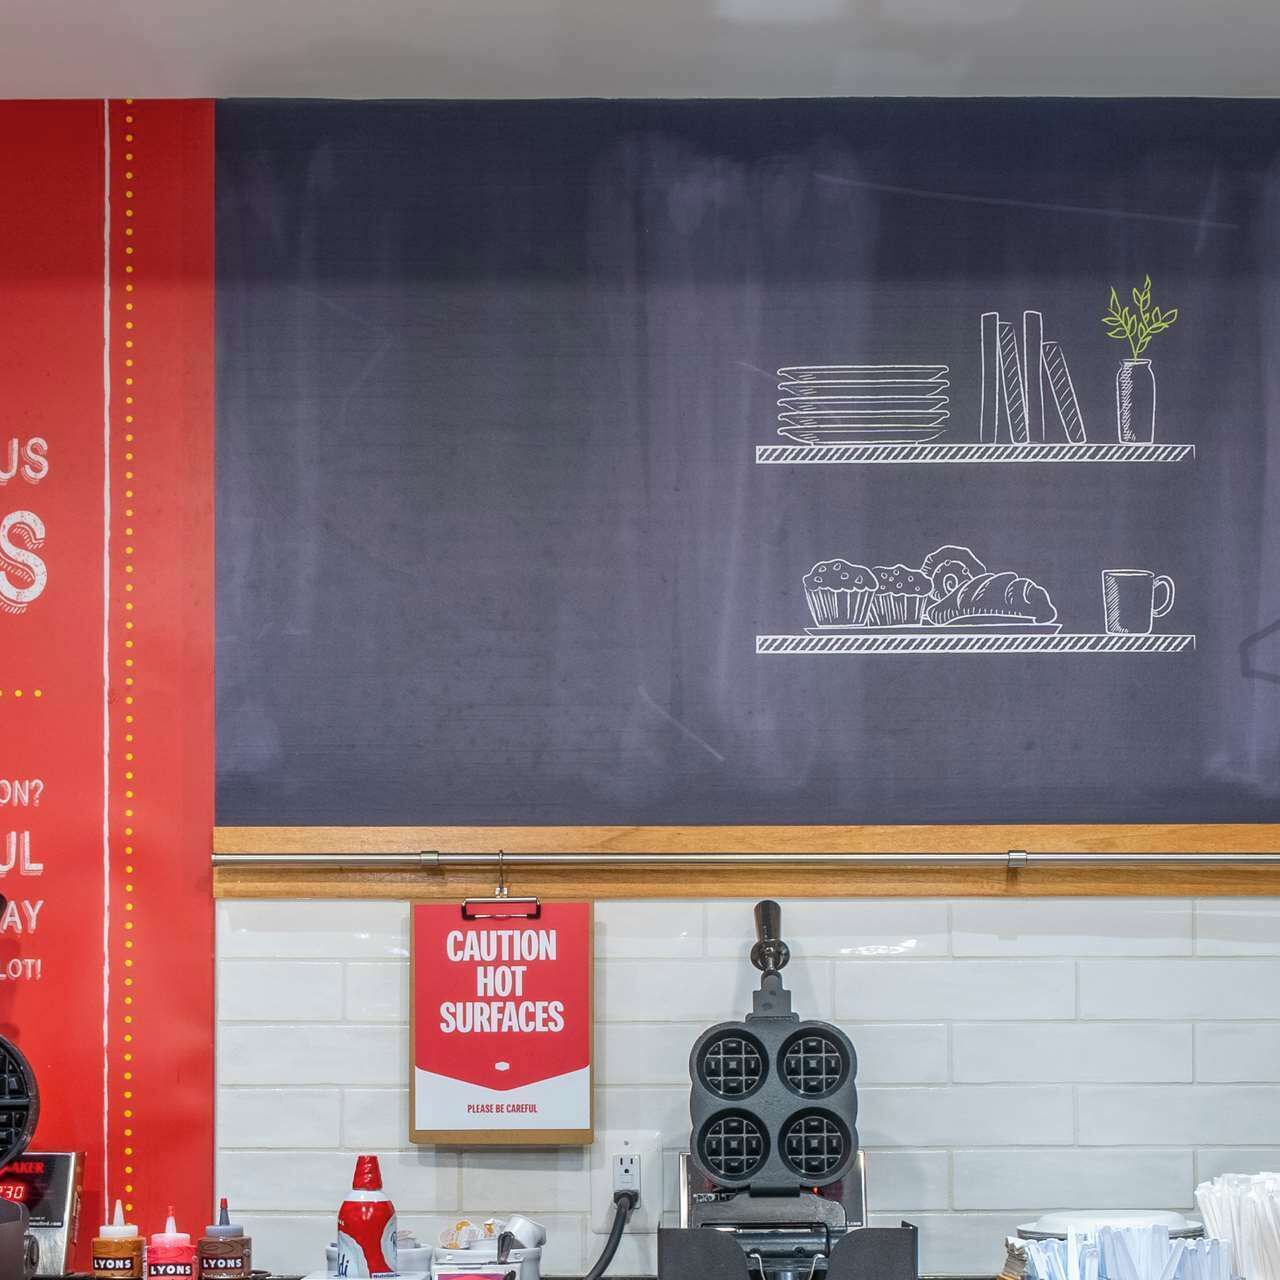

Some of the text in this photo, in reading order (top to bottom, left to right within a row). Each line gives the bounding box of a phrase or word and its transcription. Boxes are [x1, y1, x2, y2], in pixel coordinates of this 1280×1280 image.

[446, 929, 557, 962] CAUTION
[476, 965, 527, 998] HOT
[439, 1000, 565, 1034] SURFACES
[466, 1103, 539, 1114] PLEASE BE CAREFUL
[94, 1258, 132, 1269] LYONS
[203, 1258, 242, 1268] LYONS
[150, 1265, 192, 1275] LYONS
